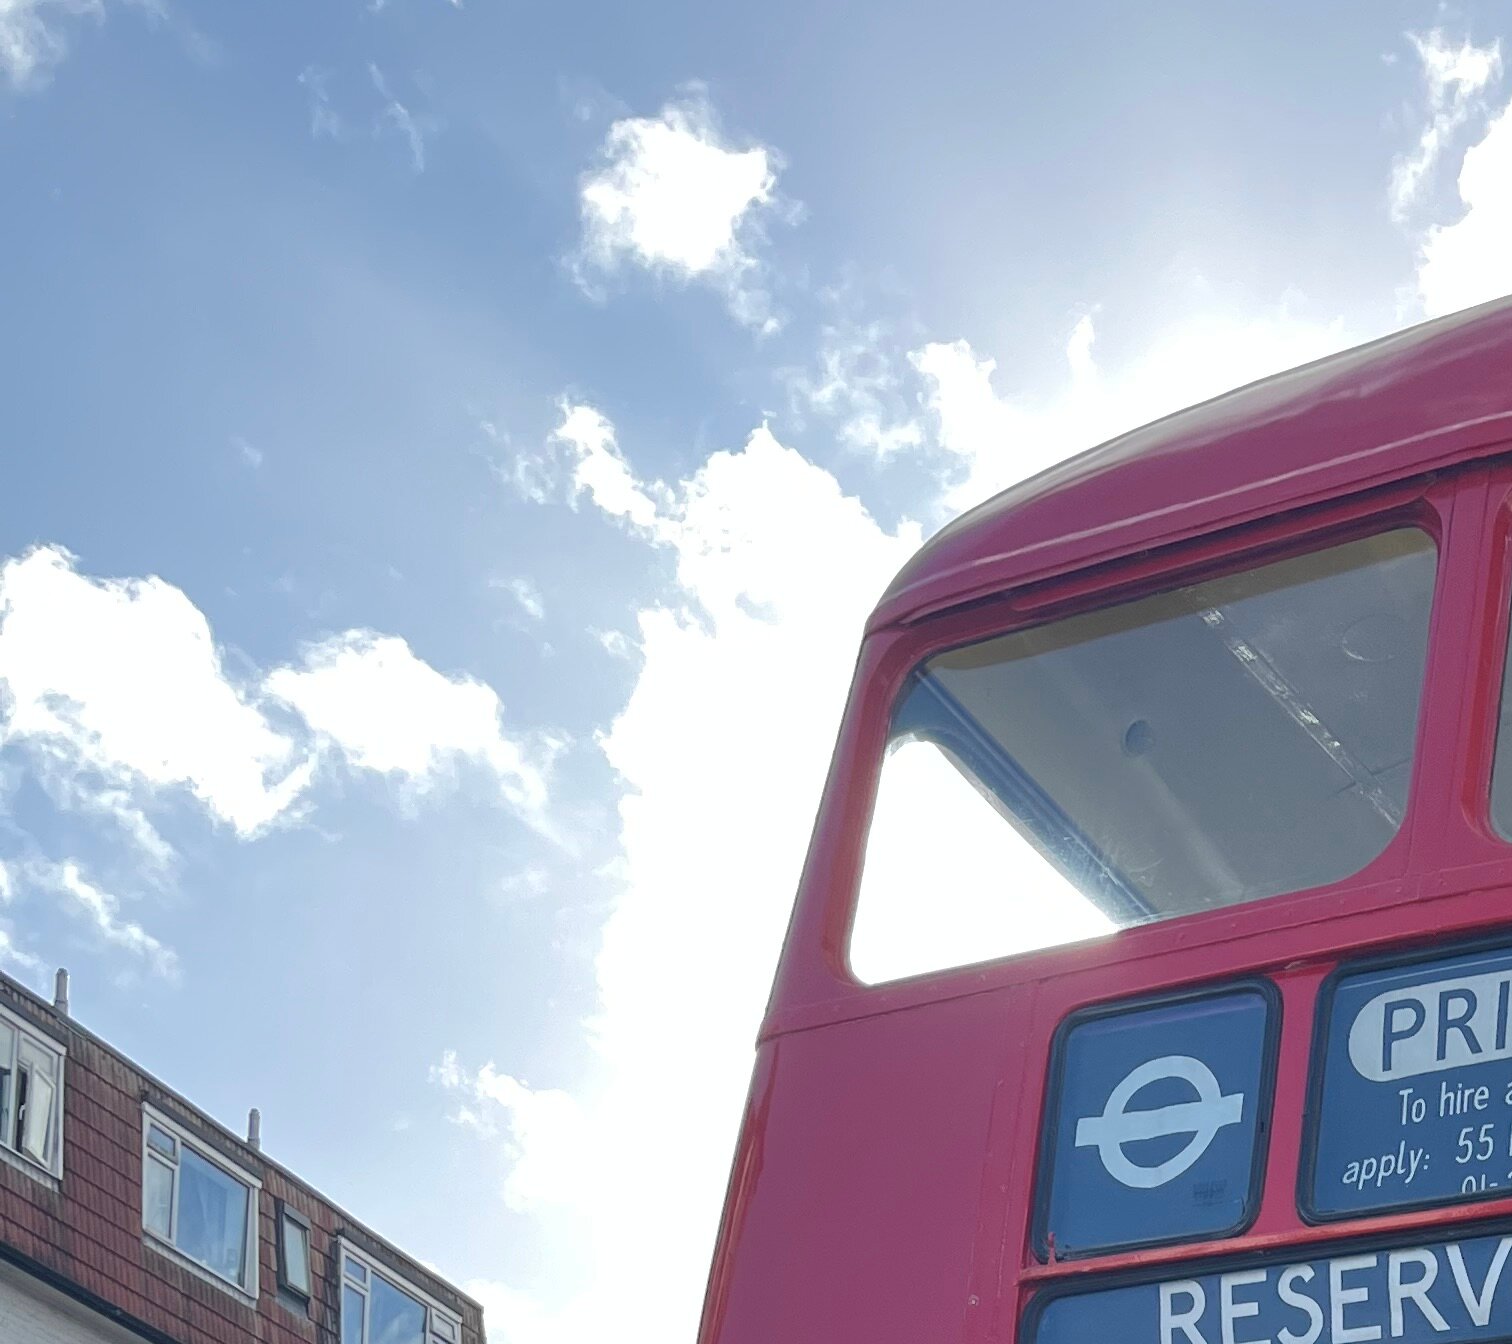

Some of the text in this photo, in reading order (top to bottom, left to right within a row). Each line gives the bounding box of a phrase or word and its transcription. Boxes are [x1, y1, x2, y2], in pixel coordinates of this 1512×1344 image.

[1398, 1088, 1426, 1126] To
[1439, 1080, 1490, 1118] hire
[1341, 1141, 1431, 1191] apply:
[1455, 1123, 1494, 1165] 55
